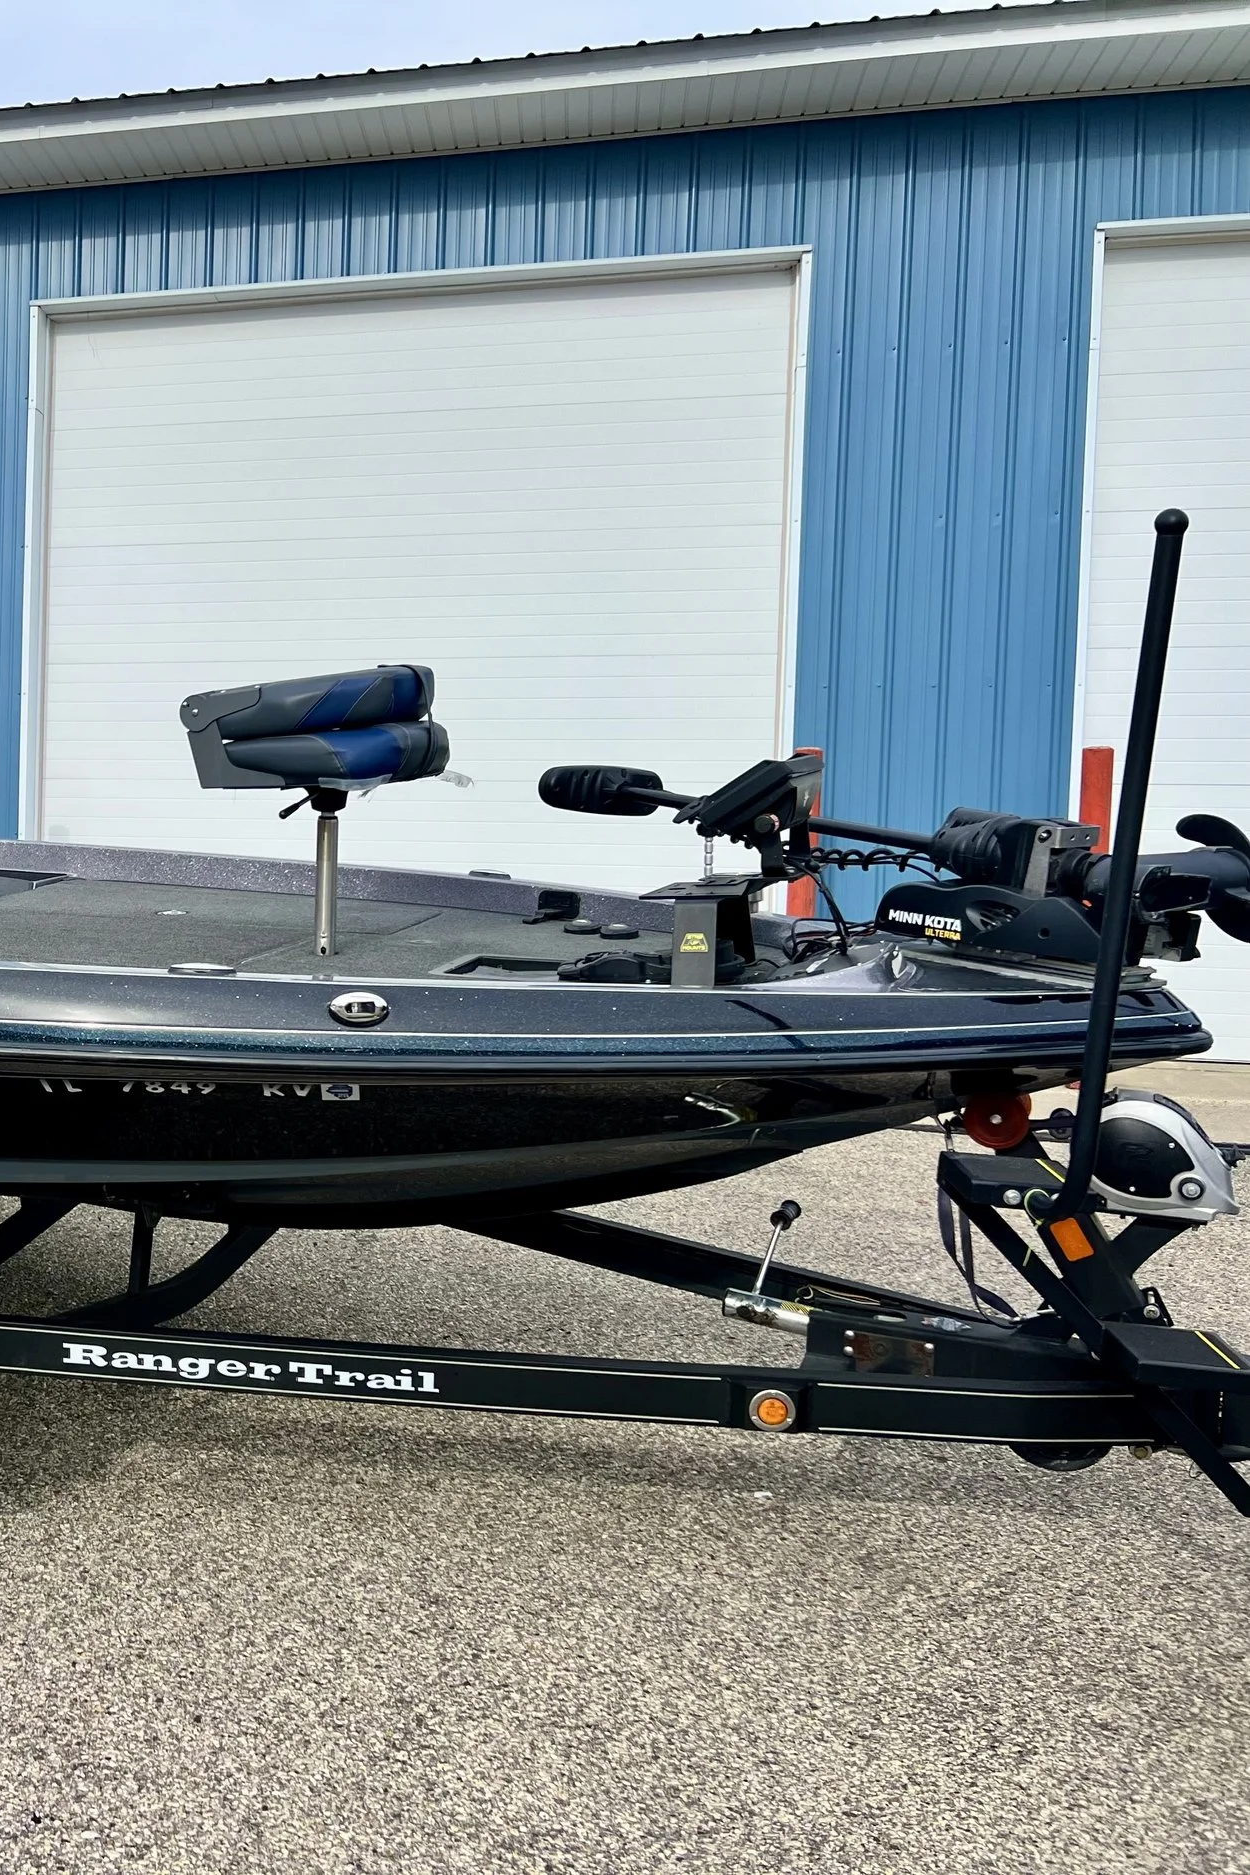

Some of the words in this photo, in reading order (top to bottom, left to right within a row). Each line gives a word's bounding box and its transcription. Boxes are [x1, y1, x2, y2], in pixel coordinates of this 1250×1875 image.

[888, 908, 923, 926] MINN
[924, 914, 962, 932] KOTA
[924, 927, 961, 941] ULTERRA
[262, 1083, 312, 1097] KV
[62, 1342, 282, 1379] Ranger
[288, 1361, 440, 1393] Trail
